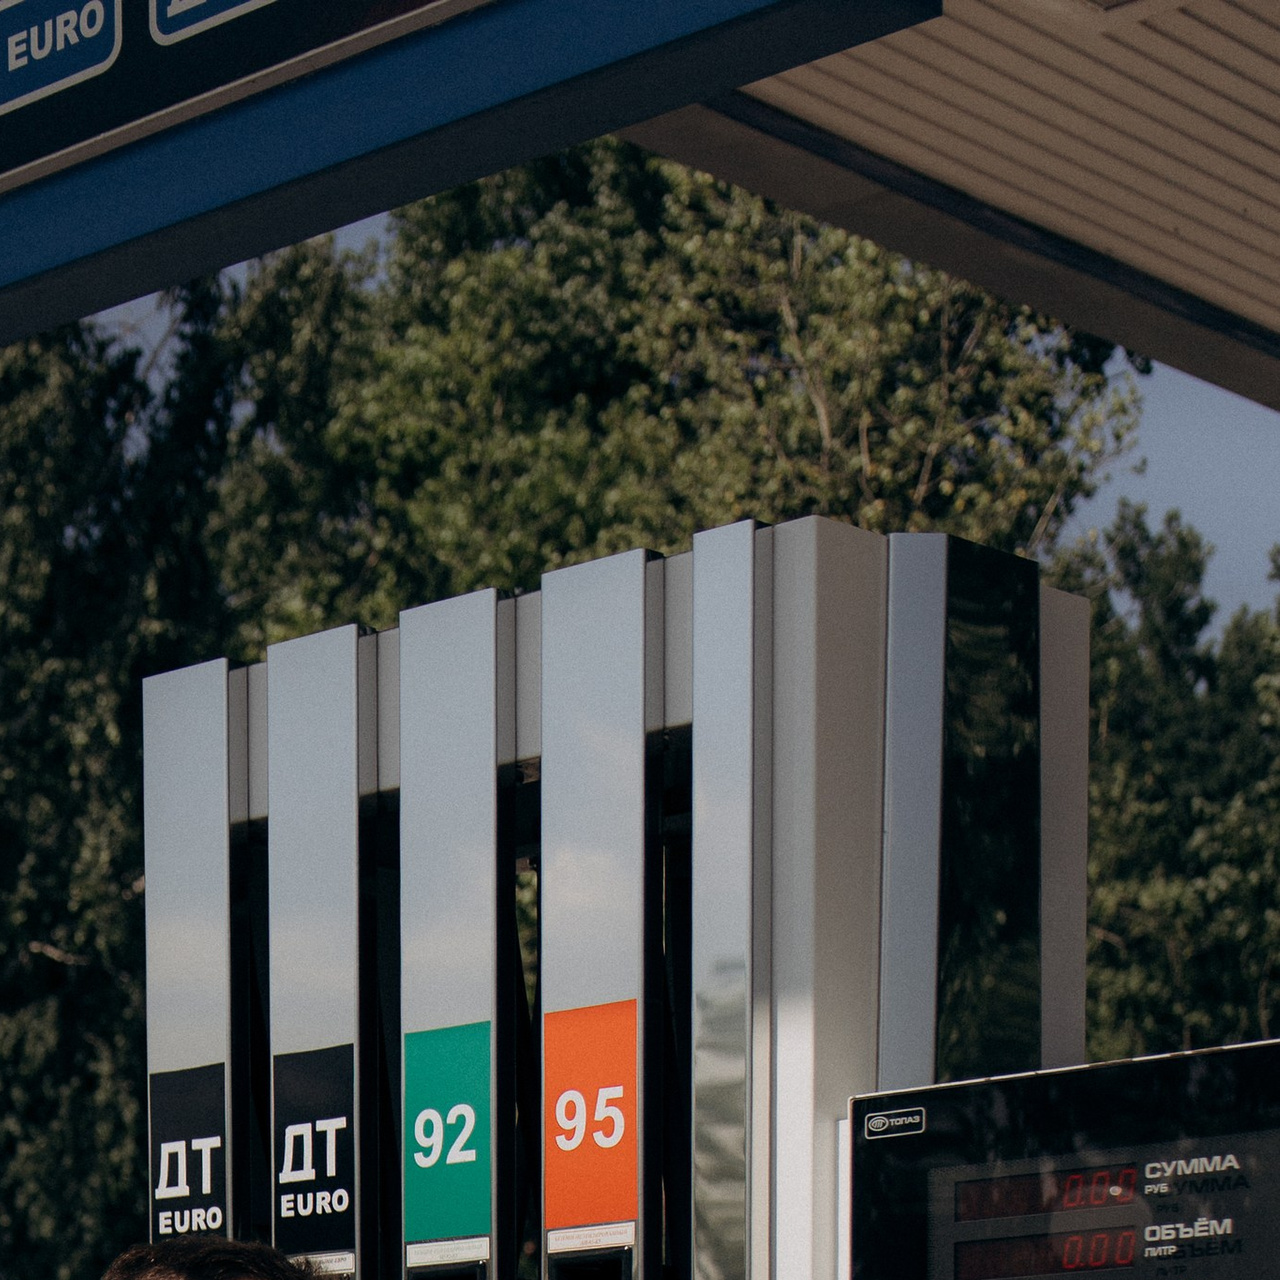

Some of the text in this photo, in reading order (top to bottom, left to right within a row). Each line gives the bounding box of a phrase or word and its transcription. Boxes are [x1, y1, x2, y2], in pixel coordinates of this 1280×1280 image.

[8, 0, 104, 72] EURO
[554, 1085, 624, 1152] 95
[890, 1115, 920, 1126] ТОПАЗ
[279, 1116, 347, 1184] ДТ
[414, 1103, 477, 1169] 92
[155, 1135, 221, 1200] ДТ
[1144, 1154, 1240, 1179] СУММА
[281, 1188, 349, 1218] EURO
[1144, 1183, 1169, 1195] РУБ
[159, 1206, 223, 1235] EURO
[1144, 1218, 1233, 1242] ОБЪЁМ
[1144, 1245, 1177, 1257] ЛИТР
